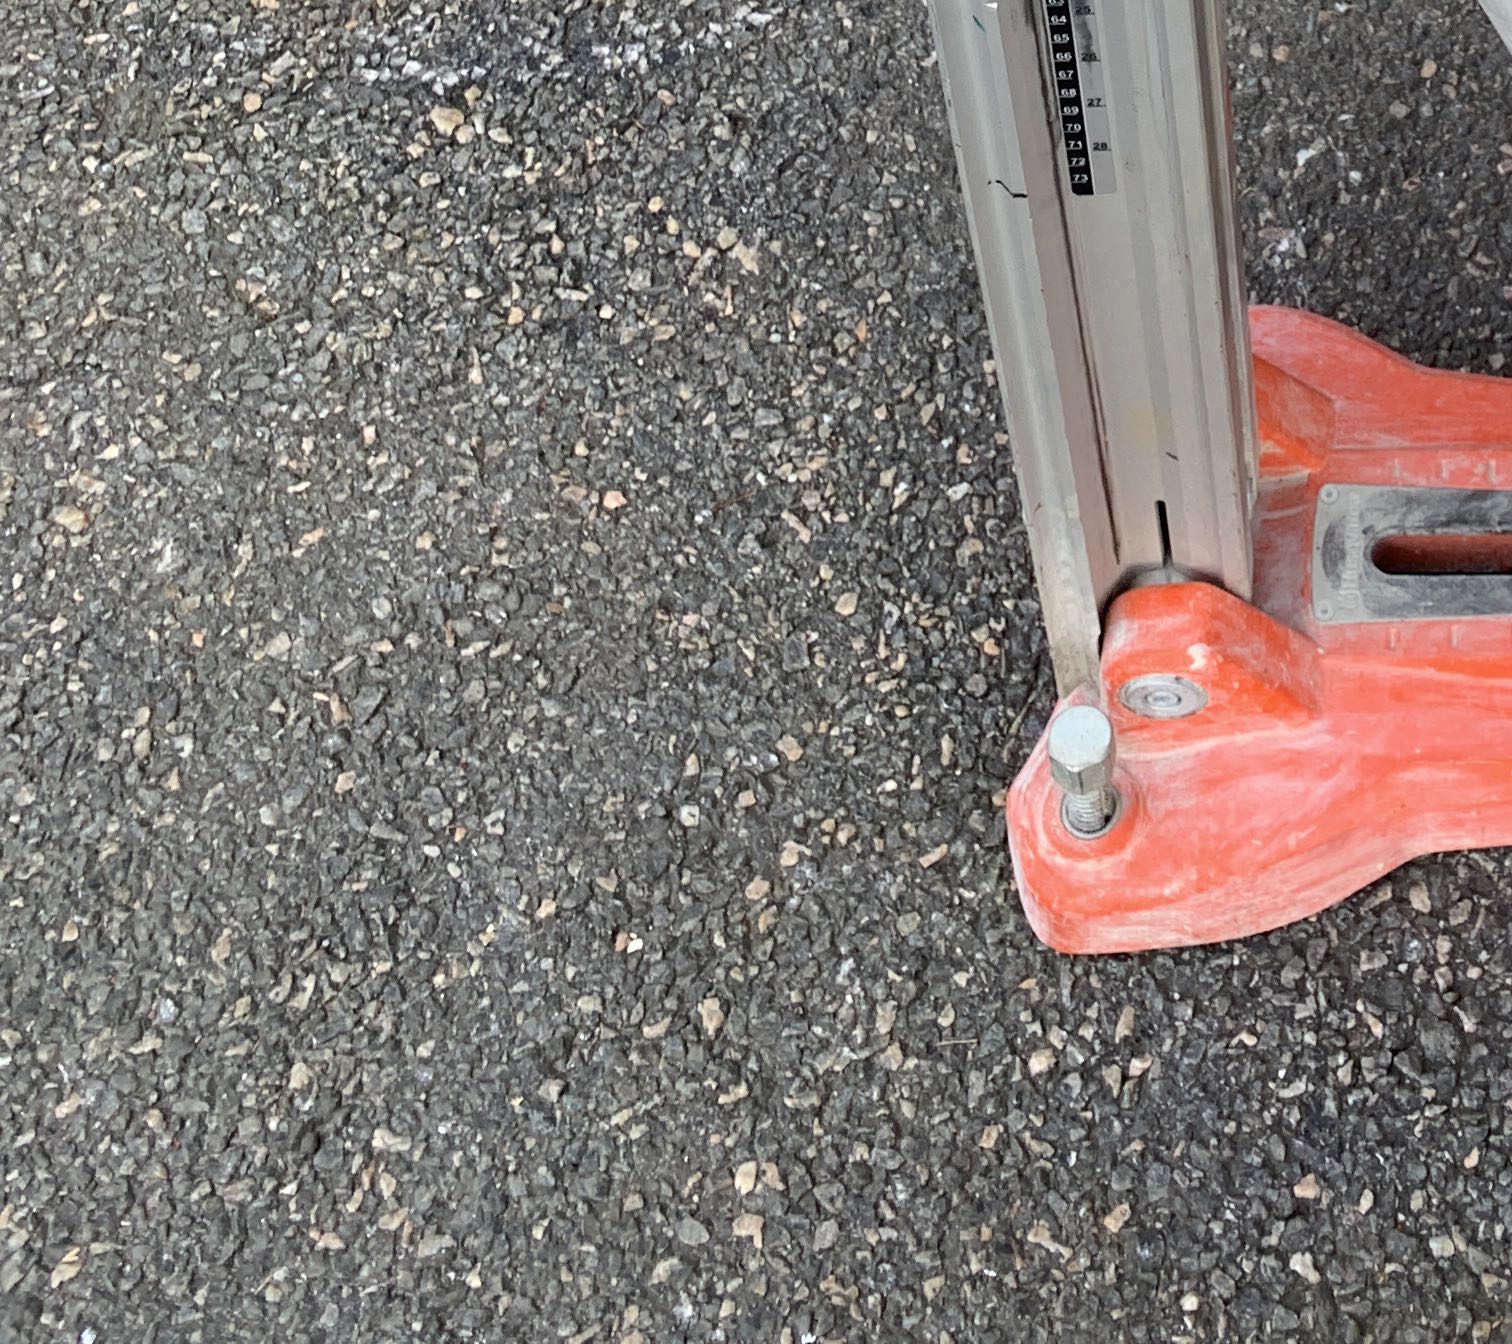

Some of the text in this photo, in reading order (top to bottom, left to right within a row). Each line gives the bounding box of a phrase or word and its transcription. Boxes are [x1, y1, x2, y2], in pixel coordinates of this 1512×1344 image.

[1049, 14, 1068, 24] 64
[1052, 32, 1071, 42] 65
[1055, 51, 1074, 61] 66
[1057, 69, 1075, 79] 67
[1060, 87, 1078, 97] 68
[1086, 97, 1103, 107] 27
[1062, 105, 1080, 115] 69
[1065, 122, 1083, 132] 70
[1067, 140, 1084, 149] 71
[1069, 156, 1087, 166] 72
[1072, 173, 1089, 183] 73
